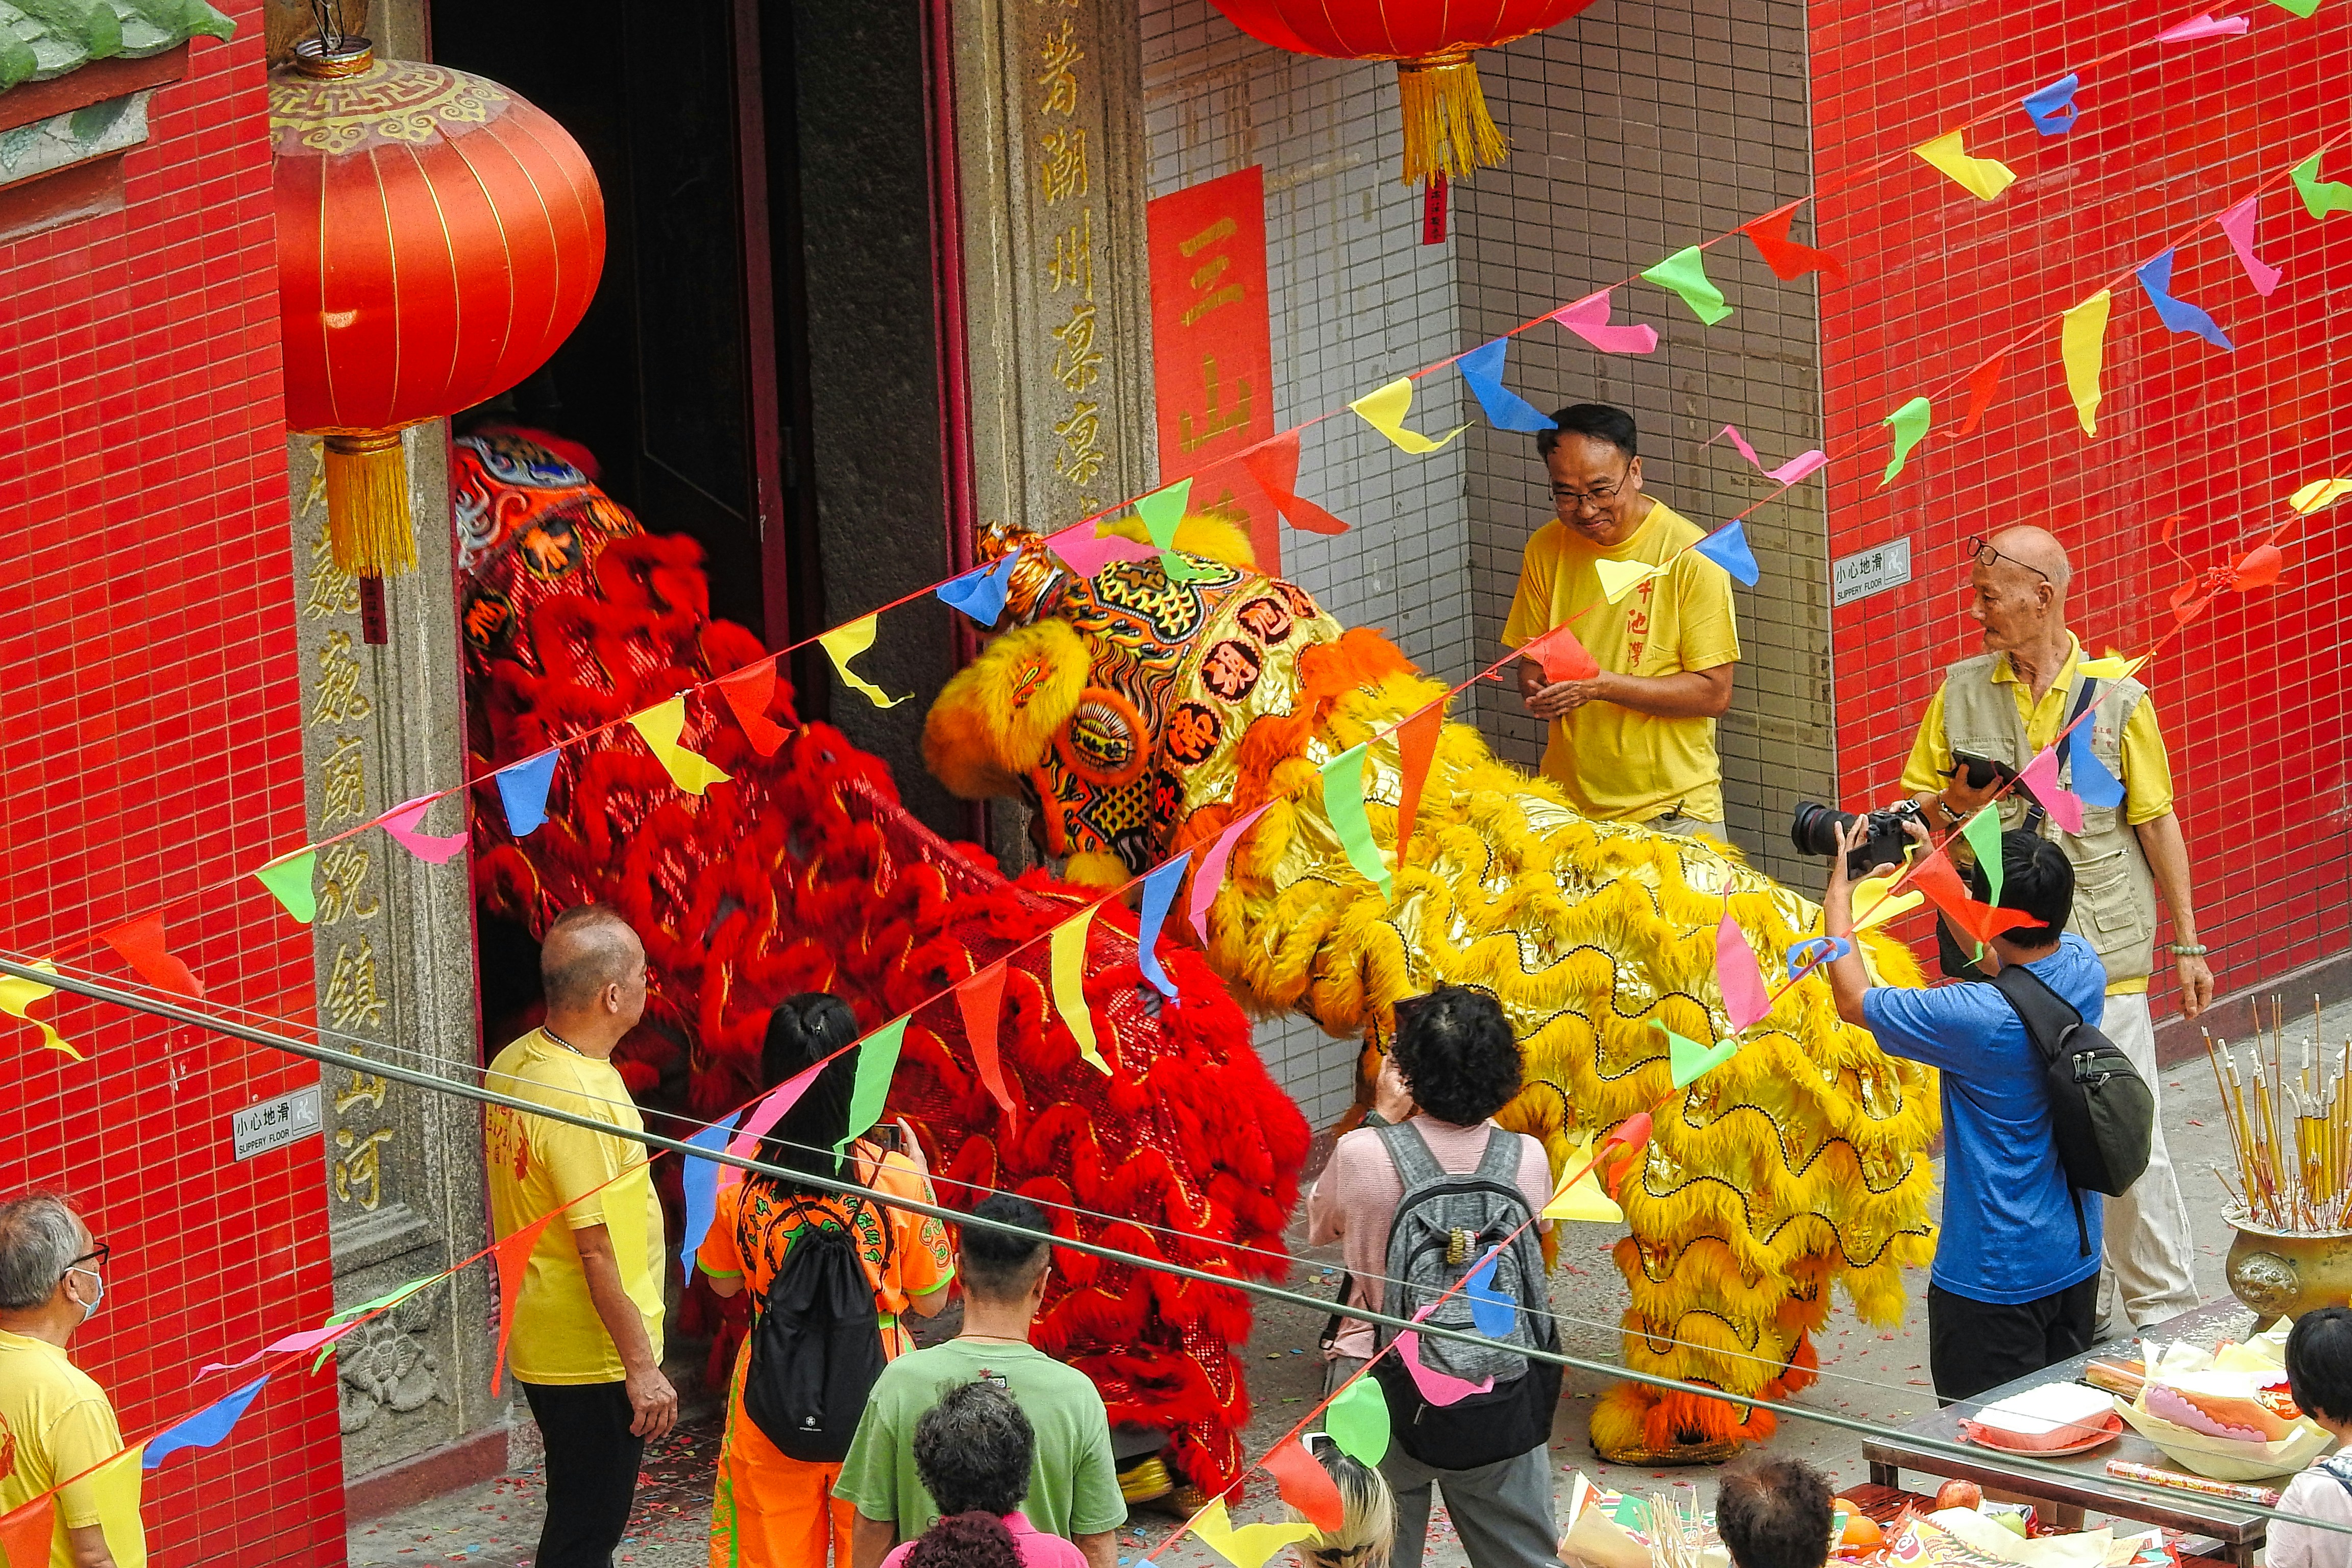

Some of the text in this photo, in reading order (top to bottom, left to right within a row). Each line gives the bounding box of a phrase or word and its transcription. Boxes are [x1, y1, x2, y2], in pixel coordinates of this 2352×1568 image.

[1836, 553, 1882, 583] 小心地滑
[1837, 578, 1882, 600] SLIPPERY FLOOR
[237, 1102, 289, 1137] 小心地滑
[239, 1129, 289, 1154] SLIPPERY FLOOR
